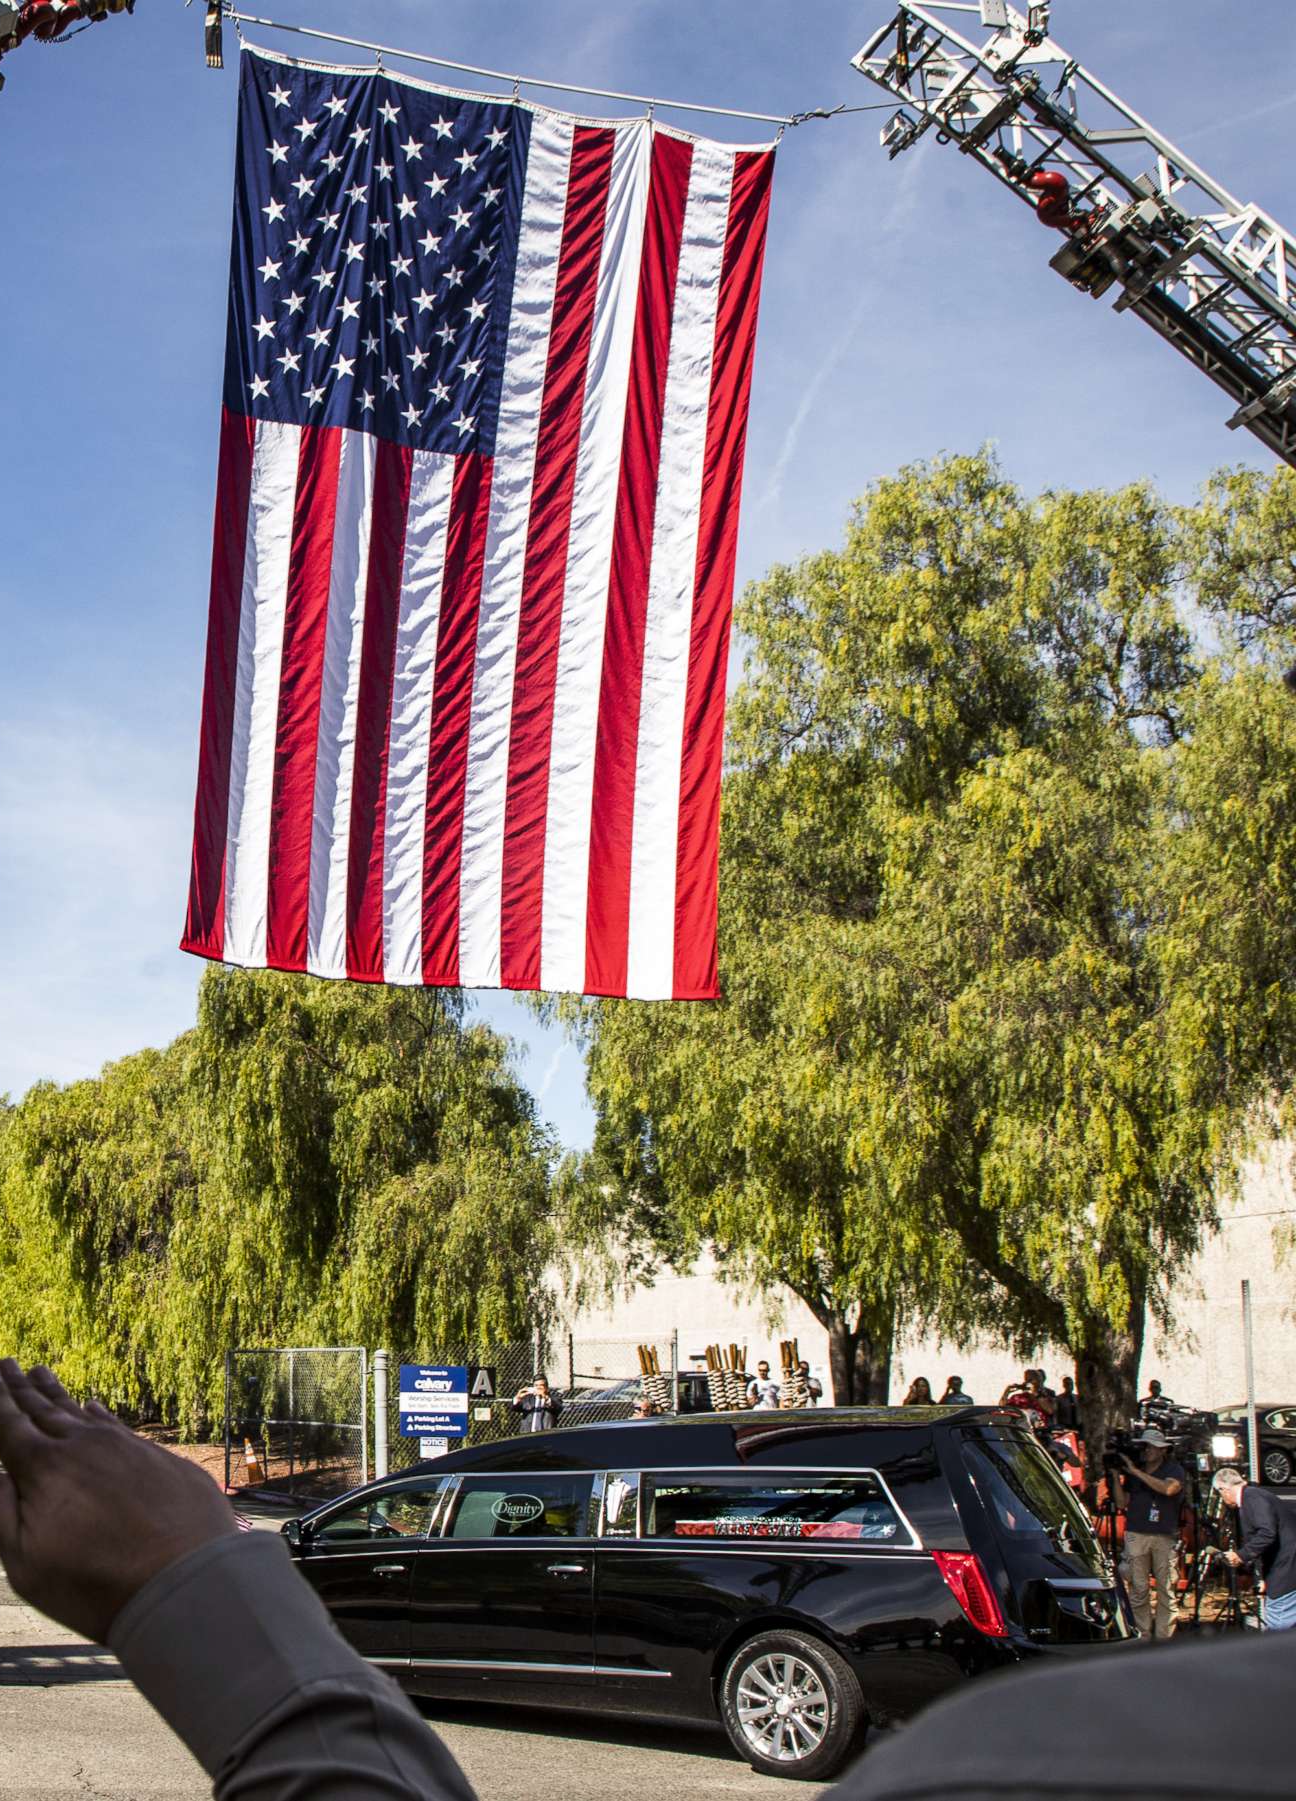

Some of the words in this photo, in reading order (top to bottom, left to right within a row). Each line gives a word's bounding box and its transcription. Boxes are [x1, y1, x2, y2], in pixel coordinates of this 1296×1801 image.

[471, 1369, 494, 1395] A
[414, 1415, 435, 1423] Parking
[414, 1424, 435, 1432] Parking
[421, 1439, 447, 1447] NOTICE
[496, 1502, 537, 1516] Dignity
